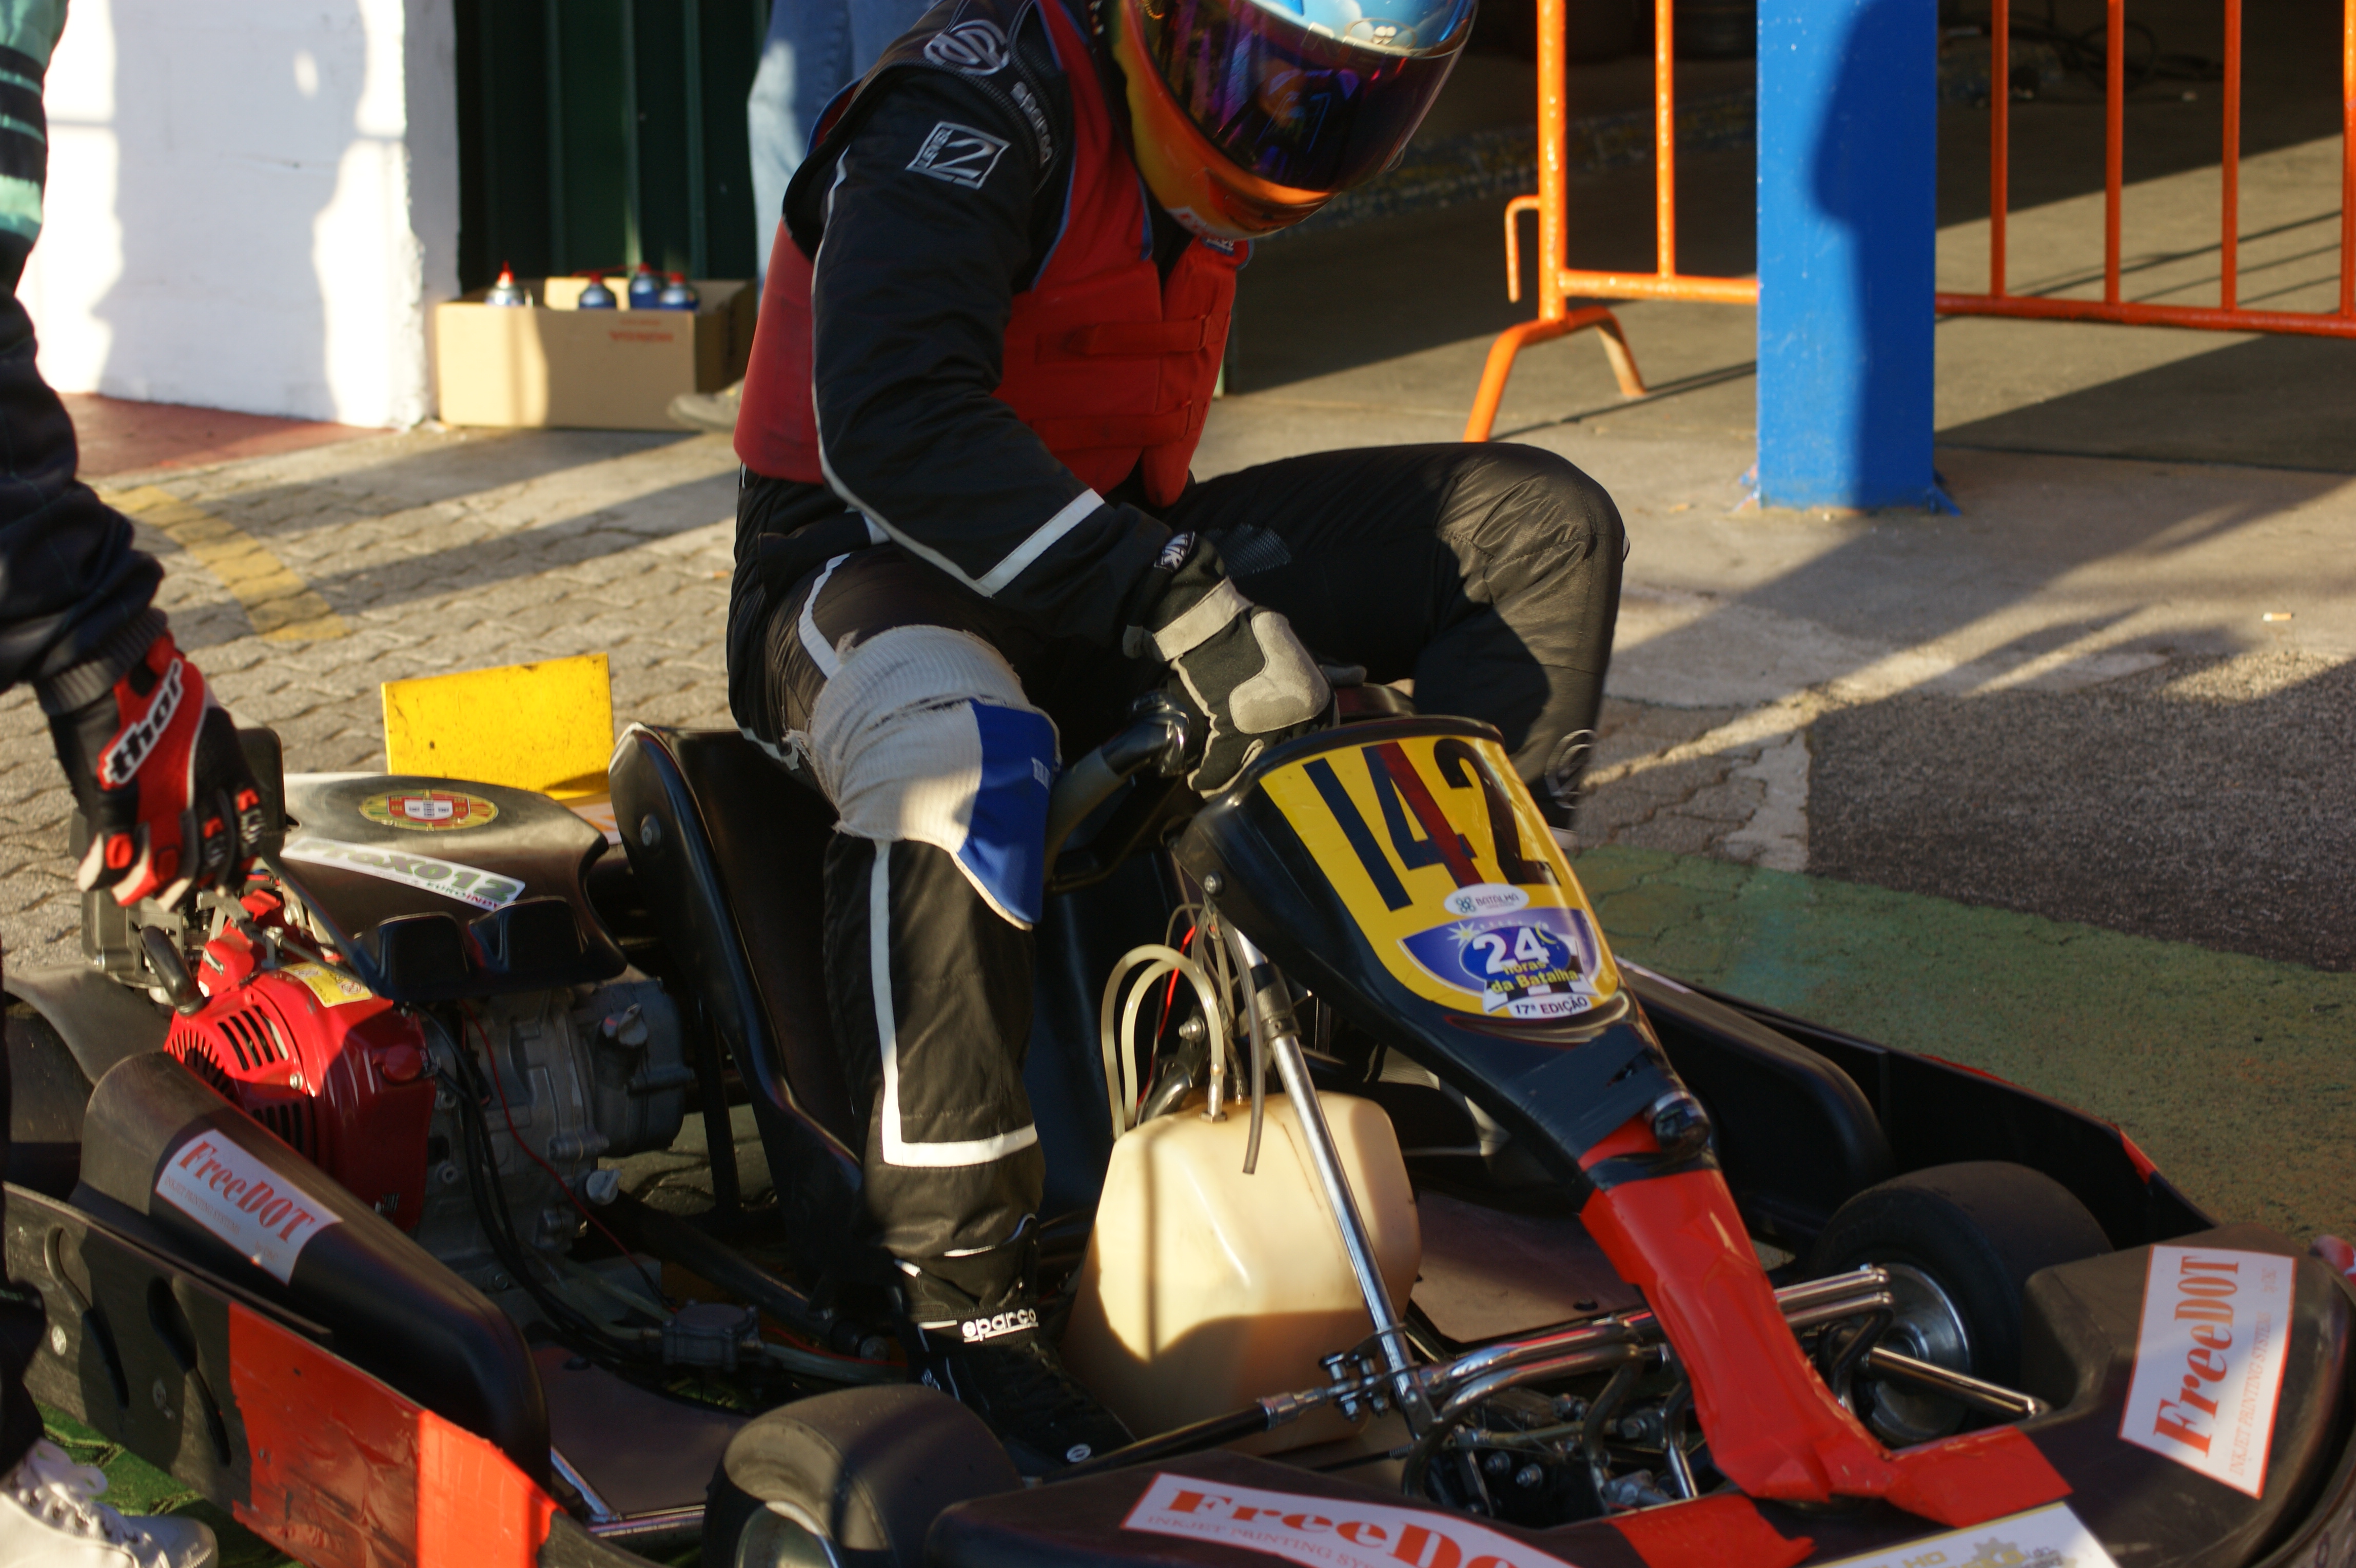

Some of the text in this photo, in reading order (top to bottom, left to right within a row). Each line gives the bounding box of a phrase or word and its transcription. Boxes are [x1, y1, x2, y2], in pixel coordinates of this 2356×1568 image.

[105, 659, 184, 783] thor
[1303, 737, 1561, 912] 142
[1475, 892, 1519, 906] BATALHA
[1472, 927, 1550, 974] 24
[1502, 960, 1547, 975] horas
[1490, 968, 1579, 994] da Batalha
[1540, 995, 1587, 1014] EDIÇÃO
[178, 1140, 316, 1244] FreeDOT
[962, 1308, 1038, 1342] sparco
[2153, 1255, 2239, 1458] FreeDOT
[2238, 1361, 2263, 1427] PRINTING
[2229, 1426, 2251, 1477] INKJET
[1147, 1515, 1225, 1534] INKJET
[1230, 1528, 1332, 1559] PRINTING
